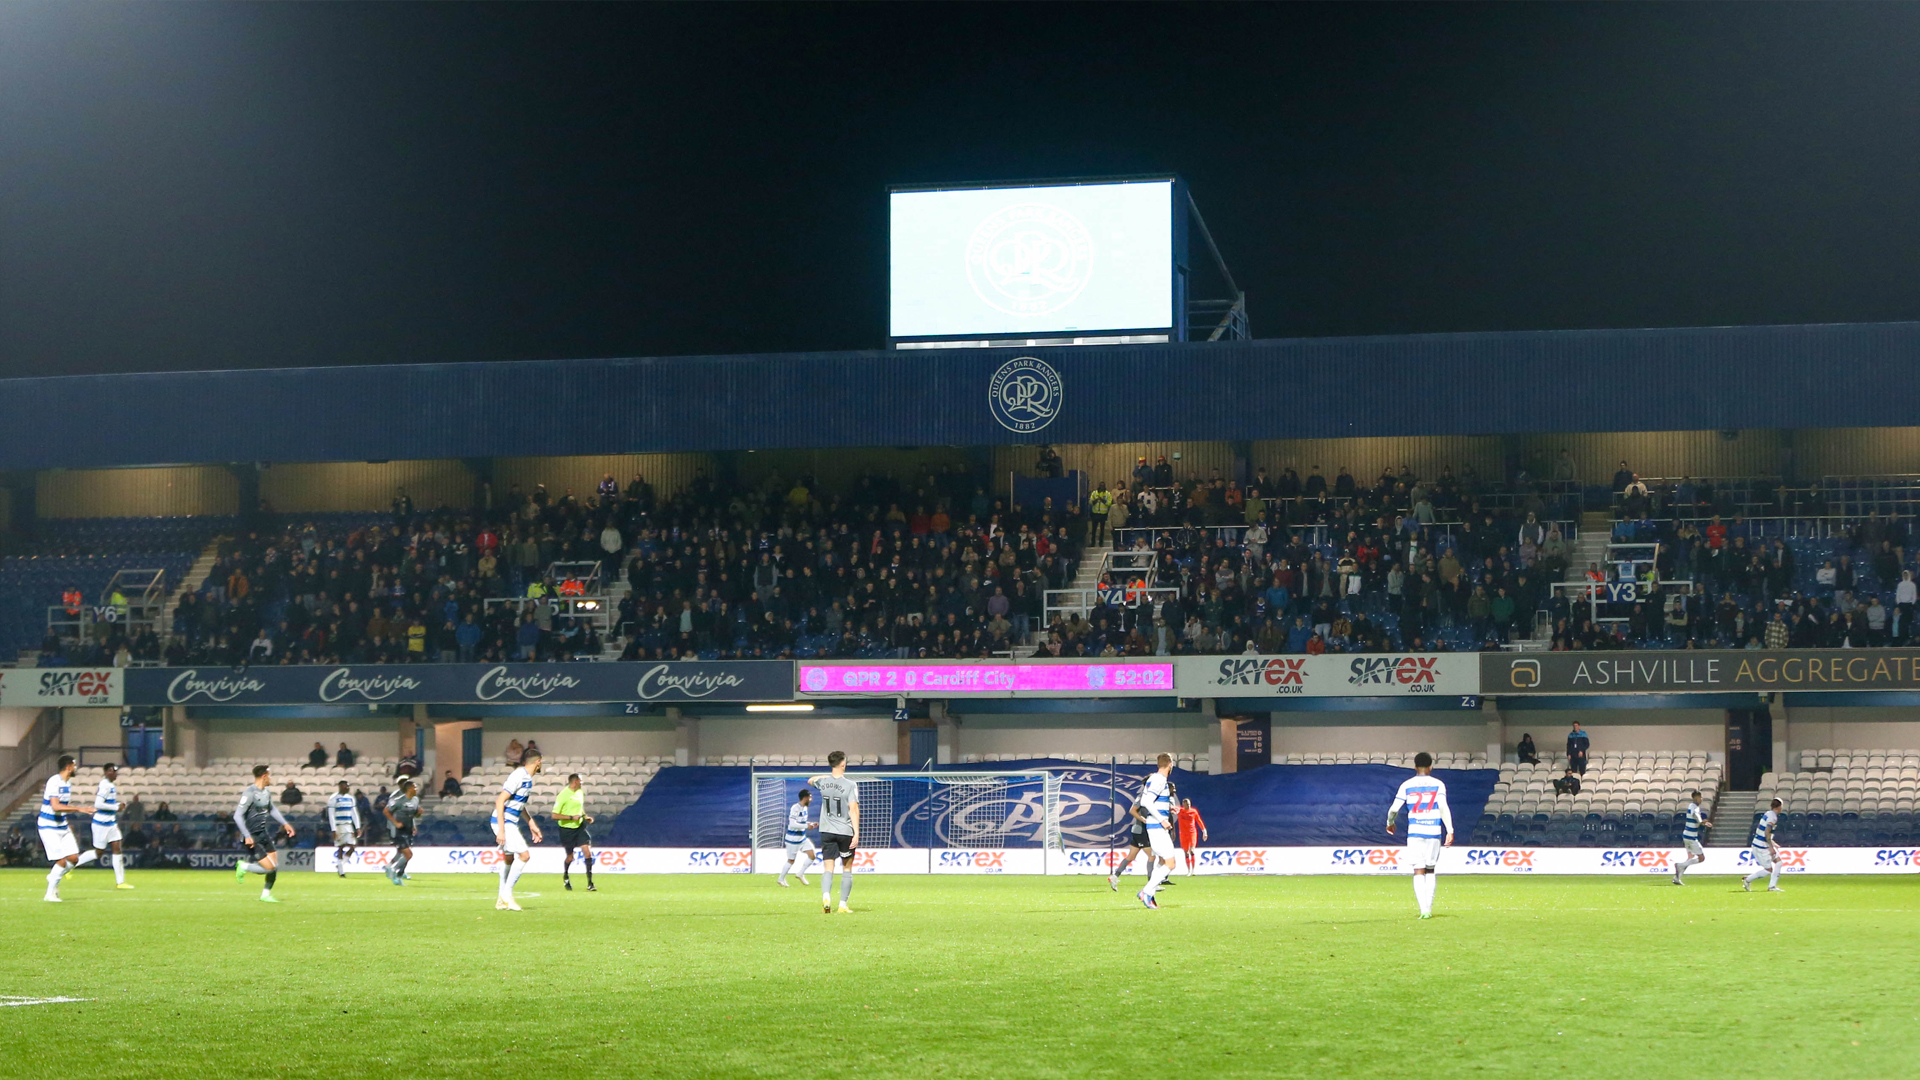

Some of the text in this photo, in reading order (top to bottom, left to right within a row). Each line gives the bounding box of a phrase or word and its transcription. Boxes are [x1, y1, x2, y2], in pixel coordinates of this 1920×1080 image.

[992, 360, 1060, 398] QUEENS PARK RANGERS
[1607, 583, 1637, 602] Y3
[476, 666, 580, 700] Convivia
[637, 664, 744, 699] Convivia
[843, 670, 1016, 689] QPR 2 0 Cardiff City
[1115, 670, 1165, 685] 52:02
[1572, 658, 1920, 684] ASHVILLE AGGREGATE
[167, 669, 265, 703] Convivia
[319, 667, 421, 702] Convivia
[823, 796, 842, 817] 11
[1409, 791, 1438, 813] 27
